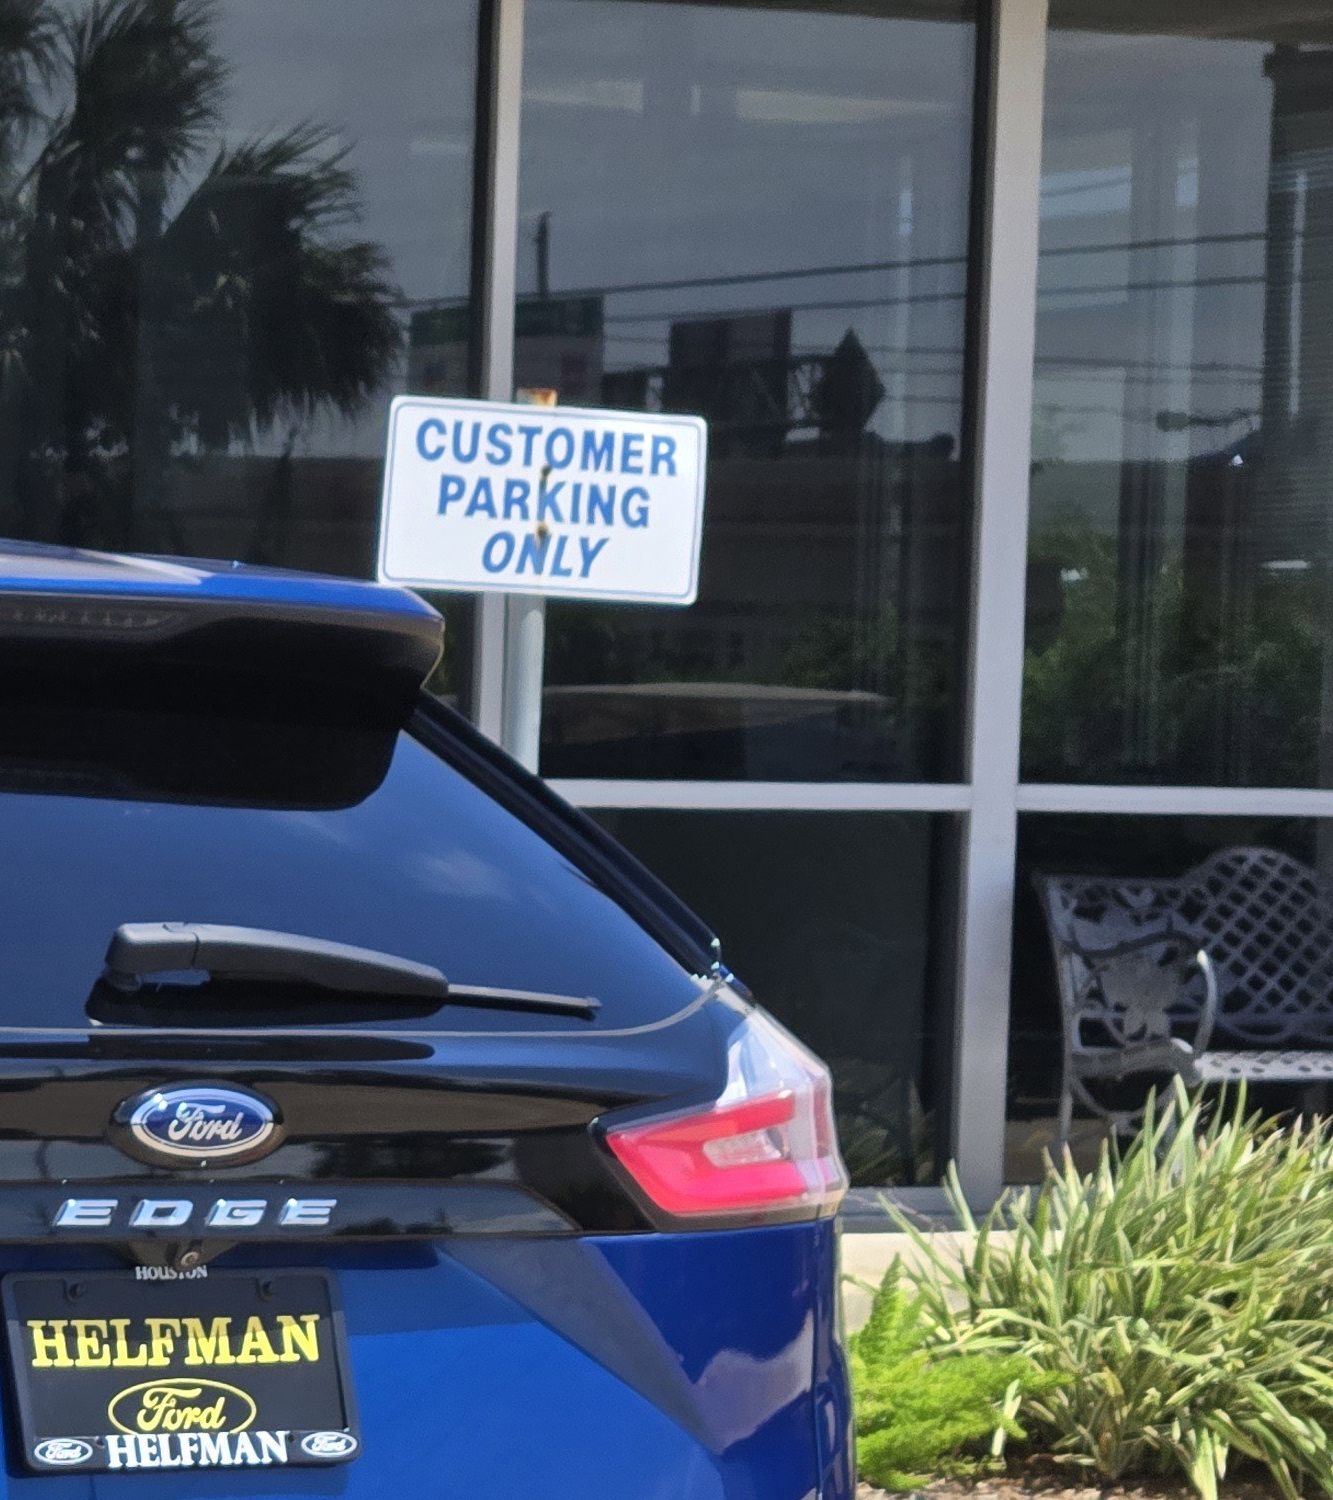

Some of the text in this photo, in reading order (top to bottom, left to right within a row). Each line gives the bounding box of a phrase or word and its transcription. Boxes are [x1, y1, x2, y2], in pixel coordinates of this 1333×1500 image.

[415, 417, 677, 476] CUSTOMER
[437, 474, 651, 529] PARKING
[482, 531, 609, 578] ONLY
[168, 1102, 244, 1142] Ford
[53, 1198, 337, 1228] EDGE
[26, 1313, 320, 1368] HELFMAN
[136, 1386, 227, 1432] Ford
[105, 1430, 291, 1469] HELFMAN
